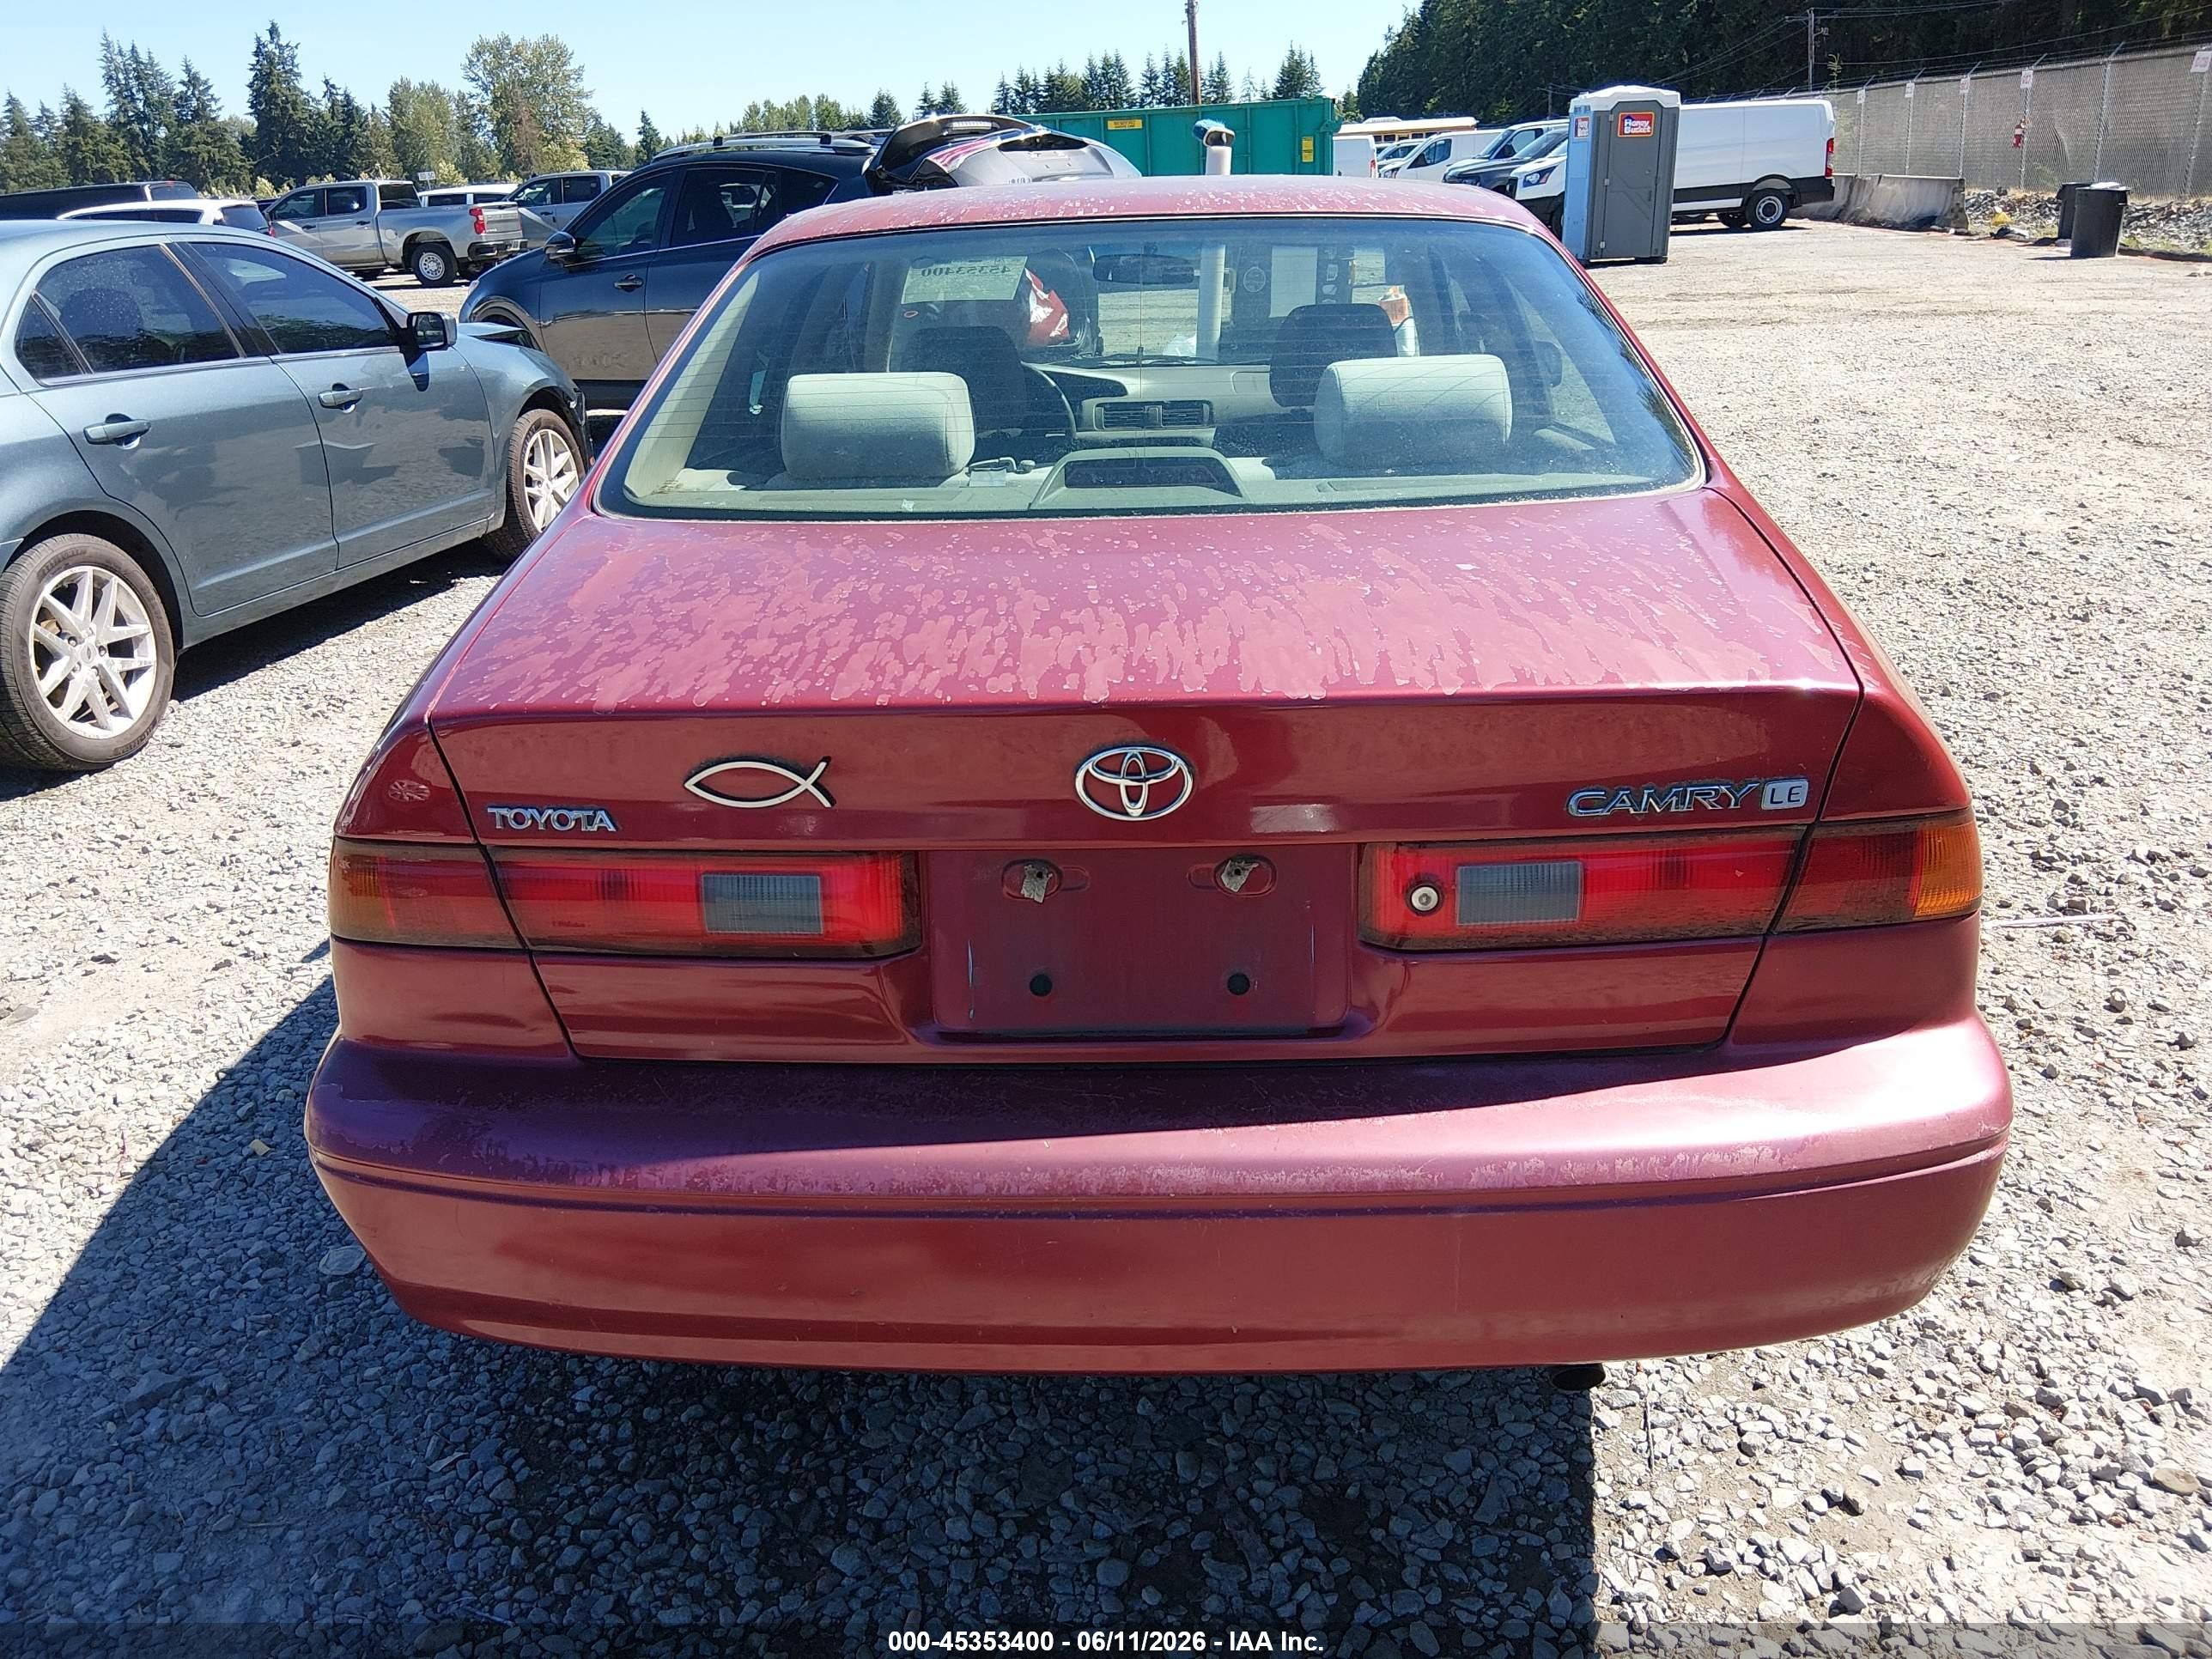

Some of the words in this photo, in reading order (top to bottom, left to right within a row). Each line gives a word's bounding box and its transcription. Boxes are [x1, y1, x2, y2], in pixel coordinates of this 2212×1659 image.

[1567, 781, 1760, 817] CAMRY
[1769, 783, 1805, 805] LE
[487, 806, 617, 832] TOYOTA
